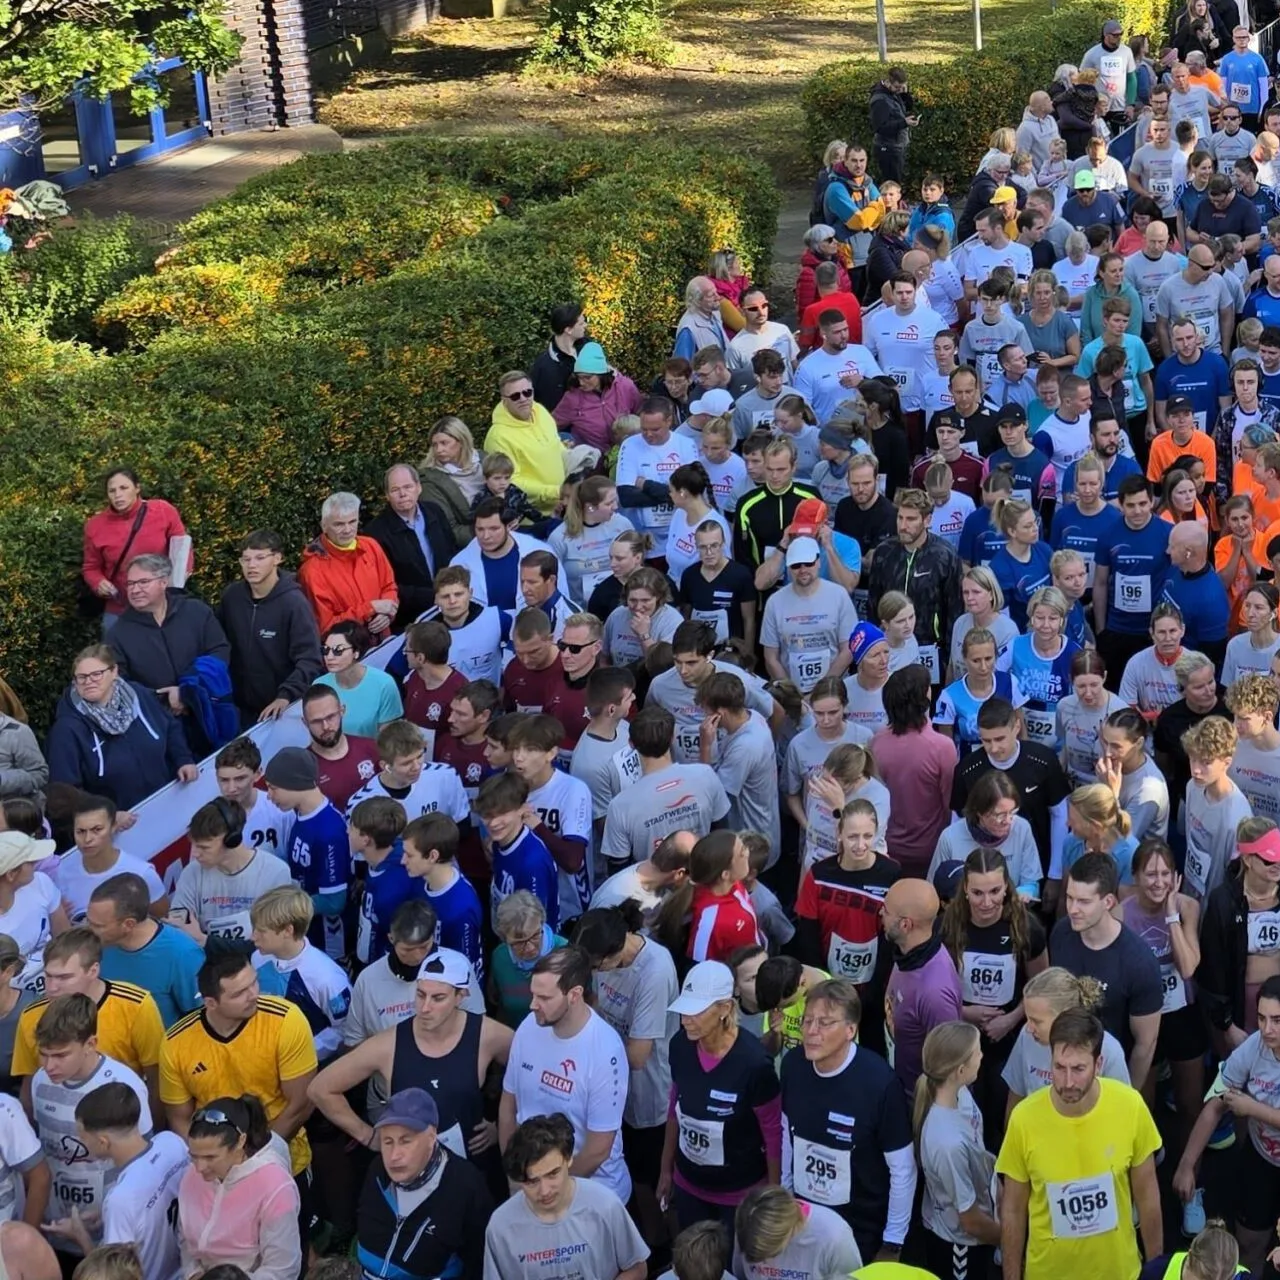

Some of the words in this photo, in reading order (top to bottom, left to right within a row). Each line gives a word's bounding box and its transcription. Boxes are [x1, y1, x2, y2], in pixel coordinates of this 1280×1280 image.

[1120, 584, 1142, 599] 196
[788, 614, 828, 623] INTERSPORT
[798, 662, 822, 677] 165
[1027, 722, 1053, 735] 522
[644, 802, 698, 828] STADTWERKE
[291, 836, 312, 868] 55
[1257, 925, 1279, 943] 46
[835, 948, 872, 968] 1430
[970, 968, 1004, 985] 864
[542, 1072, 572, 1092] ORLEN
[805, 1154, 837, 1180] 295
[53, 1181, 94, 1204] 1065
[1057, 1191, 1108, 1216] 1058
[526, 1243, 588, 1262] INTERSPORT
[757, 1264, 810, 1280] INTERSPORT
